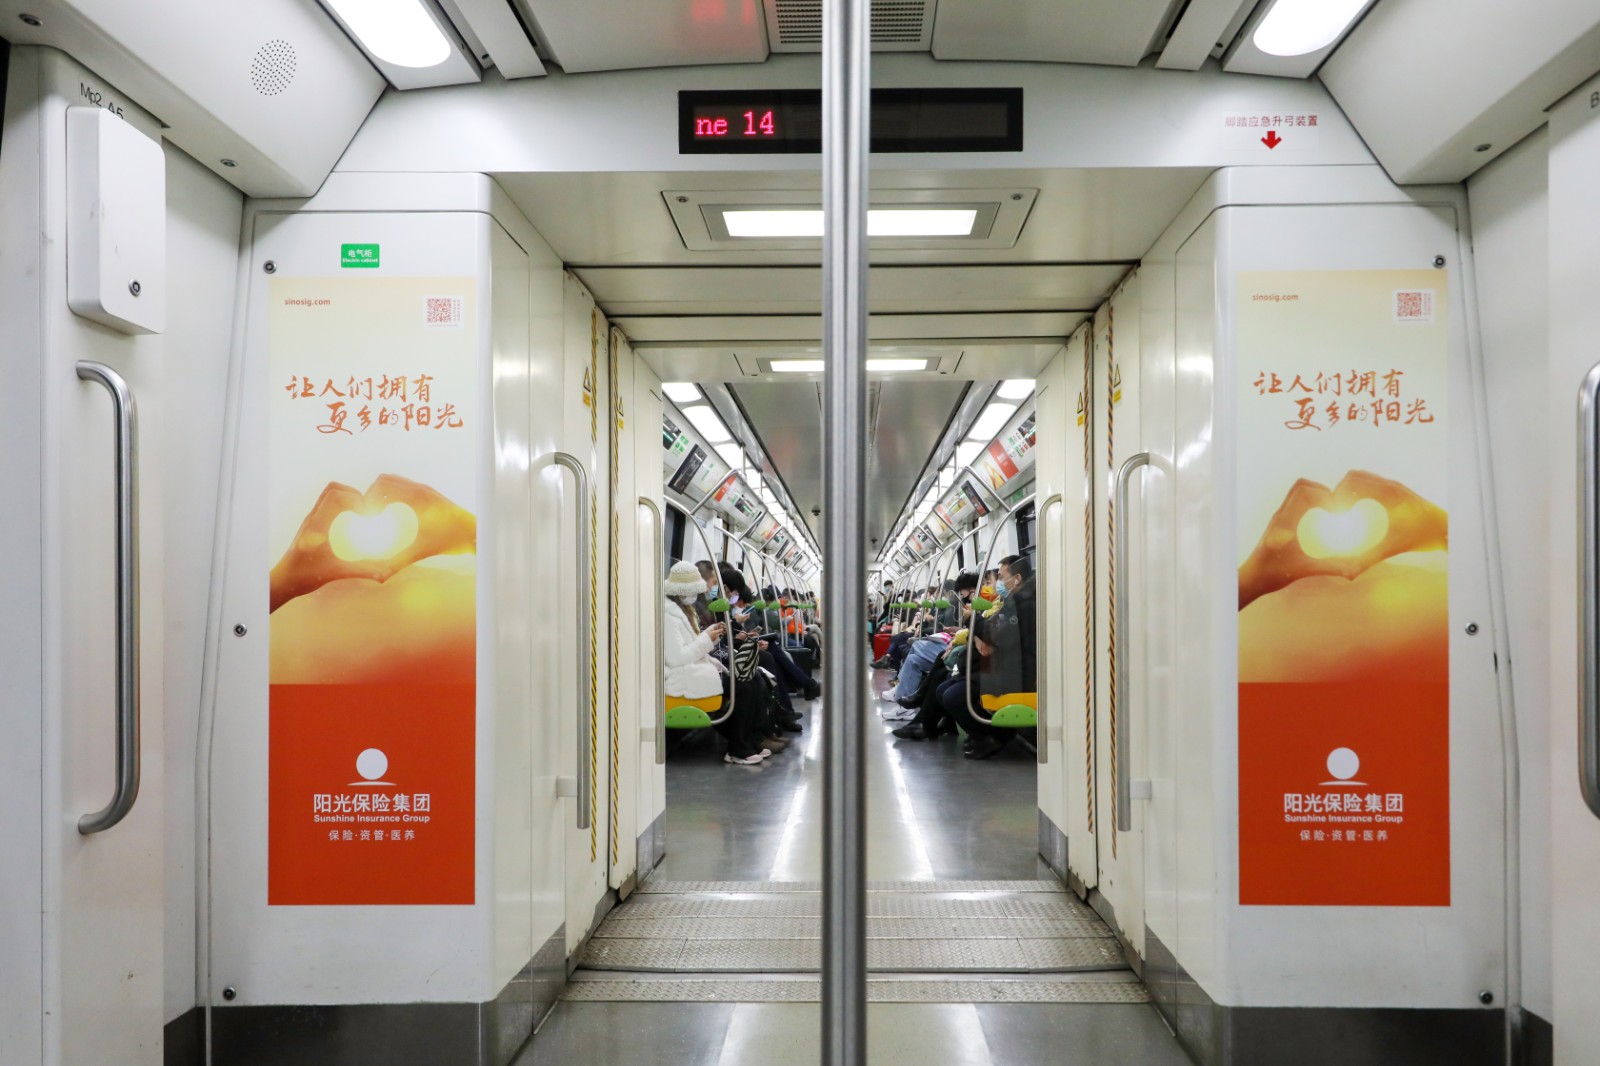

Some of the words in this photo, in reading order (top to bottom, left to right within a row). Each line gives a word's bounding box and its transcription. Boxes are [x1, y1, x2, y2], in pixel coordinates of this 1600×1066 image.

[80, 82, 102, 107] Mp2
[695, 117, 728, 135] ne
[743, 111, 774, 135] 14
[1224, 115, 1318, 128] 脚踏应急升弓装置
[348, 249, 373, 258] 电气柜
[284, 298, 331, 307] sinosig.com
[1252, 293, 1299, 302] sinosig.com
[285, 374, 434, 403] 让人们拥有
[1253, 369, 1404, 398] 让人们拥有
[316, 401, 464, 435] 更多的阳光
[1284, 397, 1434, 431] 更多的阳光
[313, 793, 431, 813] 阳光保险集团
[1283, 793, 1404, 813] 阳光保险集团
[313, 814, 355, 823] Sunshine
[357, 814, 400, 823] Insurance
[402, 814, 431, 824] Group
[1284, 814, 1326, 823] Sunshine
[1328, 814, 1372, 823] Insurance
[1374, 814, 1403, 824] Group
